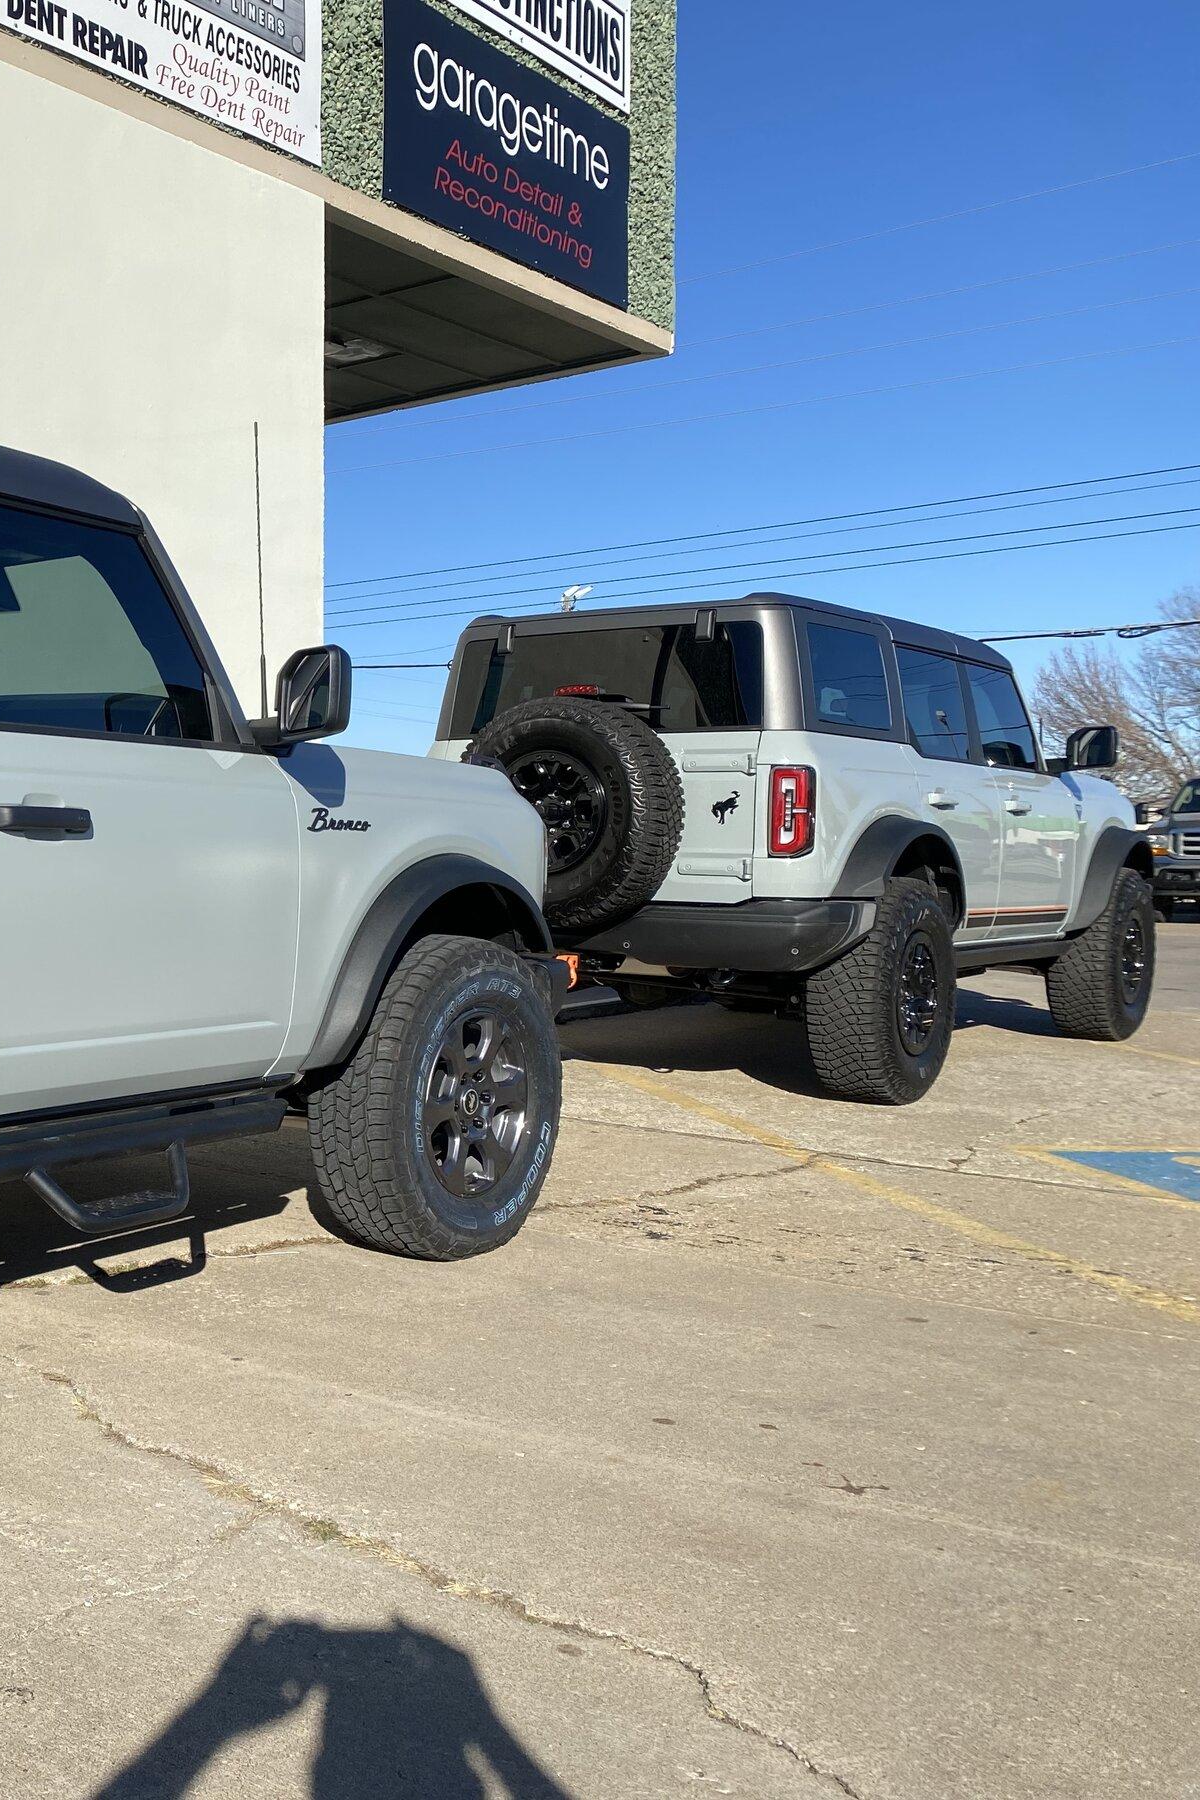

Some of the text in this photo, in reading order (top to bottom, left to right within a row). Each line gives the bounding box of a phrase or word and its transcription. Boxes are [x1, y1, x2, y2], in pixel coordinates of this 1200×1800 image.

[7, 0, 149, 79] DENT REPAIR
[138, 0, 301, 94] & TRUCK ACCESSORIES
[231, 0, 286, 37] LINERS
[492, 0, 621, 82] NCTIONS
[156, 64, 306, 148] Free Dent Repair
[173, 43, 291, 115] Quality Paint
[413, 42, 610, 190] garagetime
[434, 166, 593, 269] Reconditioning
[445, 139, 583, 228] Auto Detail &
[307, 807, 372, 832] Bronco
[486, 978, 522, 999] AT3
[494, 1121, 551, 1226] COOPER
